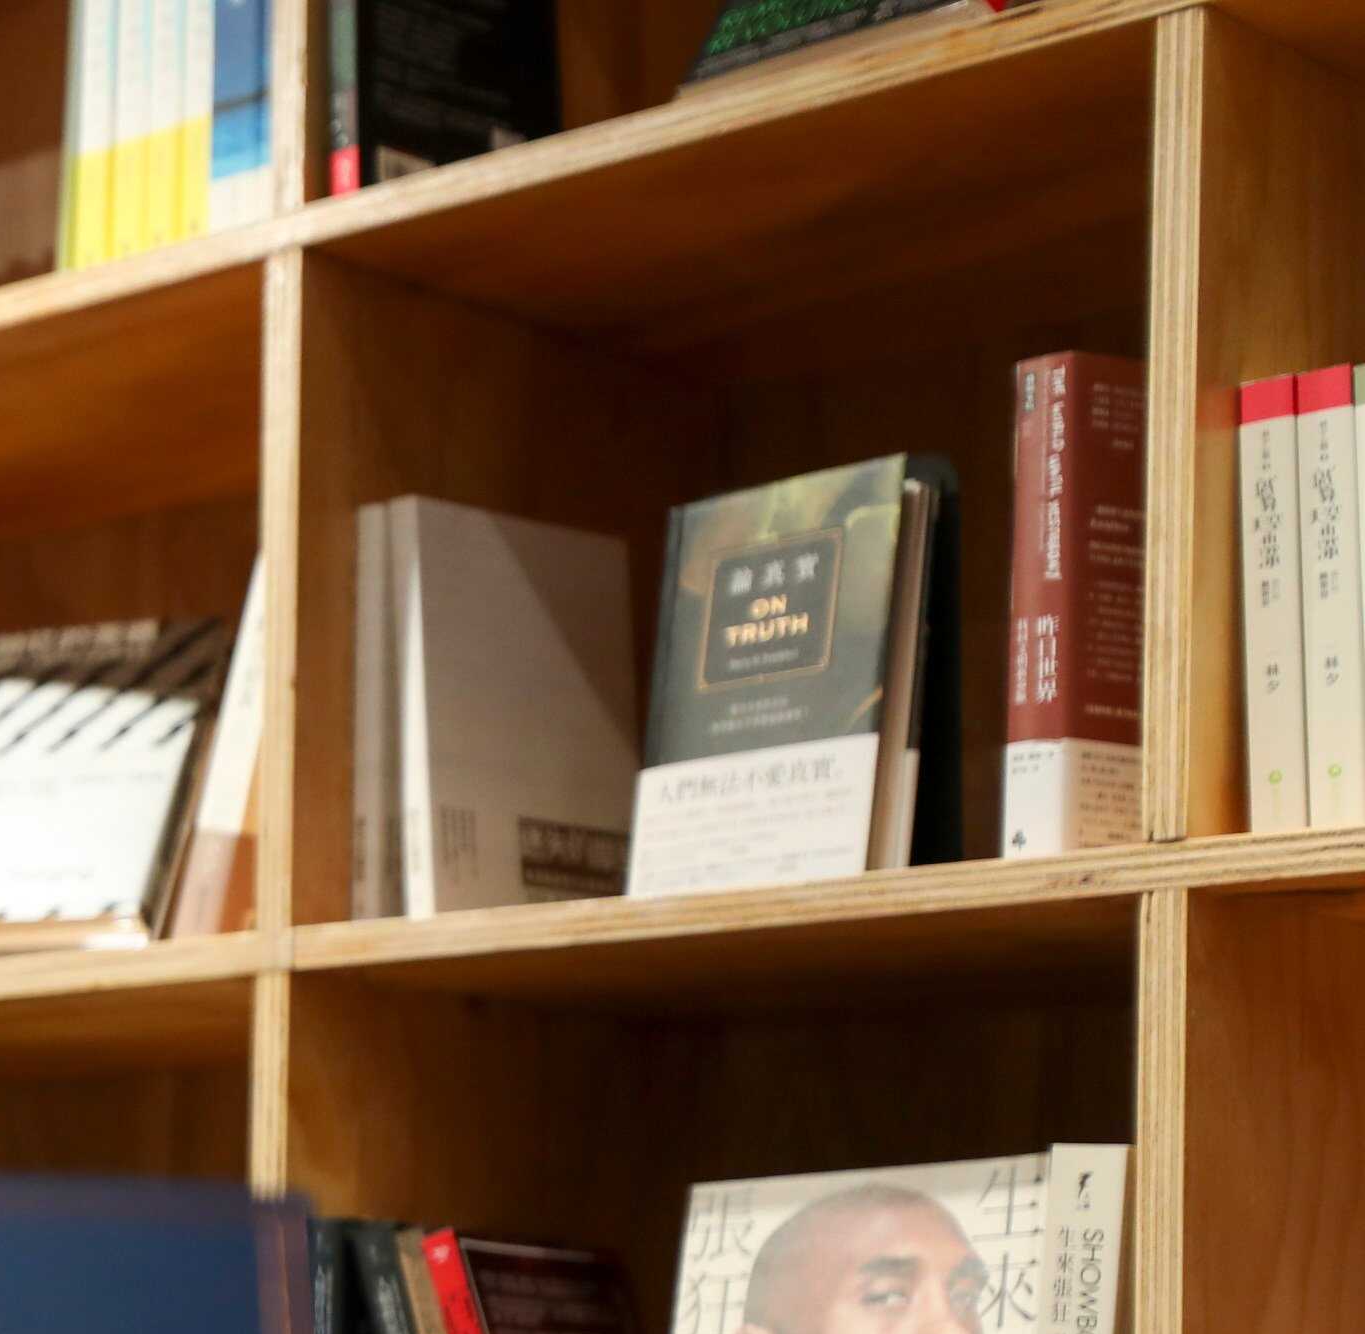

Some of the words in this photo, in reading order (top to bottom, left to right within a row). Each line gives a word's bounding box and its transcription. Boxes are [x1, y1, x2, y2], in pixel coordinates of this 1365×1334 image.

[722, 611, 810, 648] TRUTH
[748, 593, 788, 620] ON
[1036, 614, 1060, 704] 昨日世界
[971, 1163, 1046, 1330] 生來
